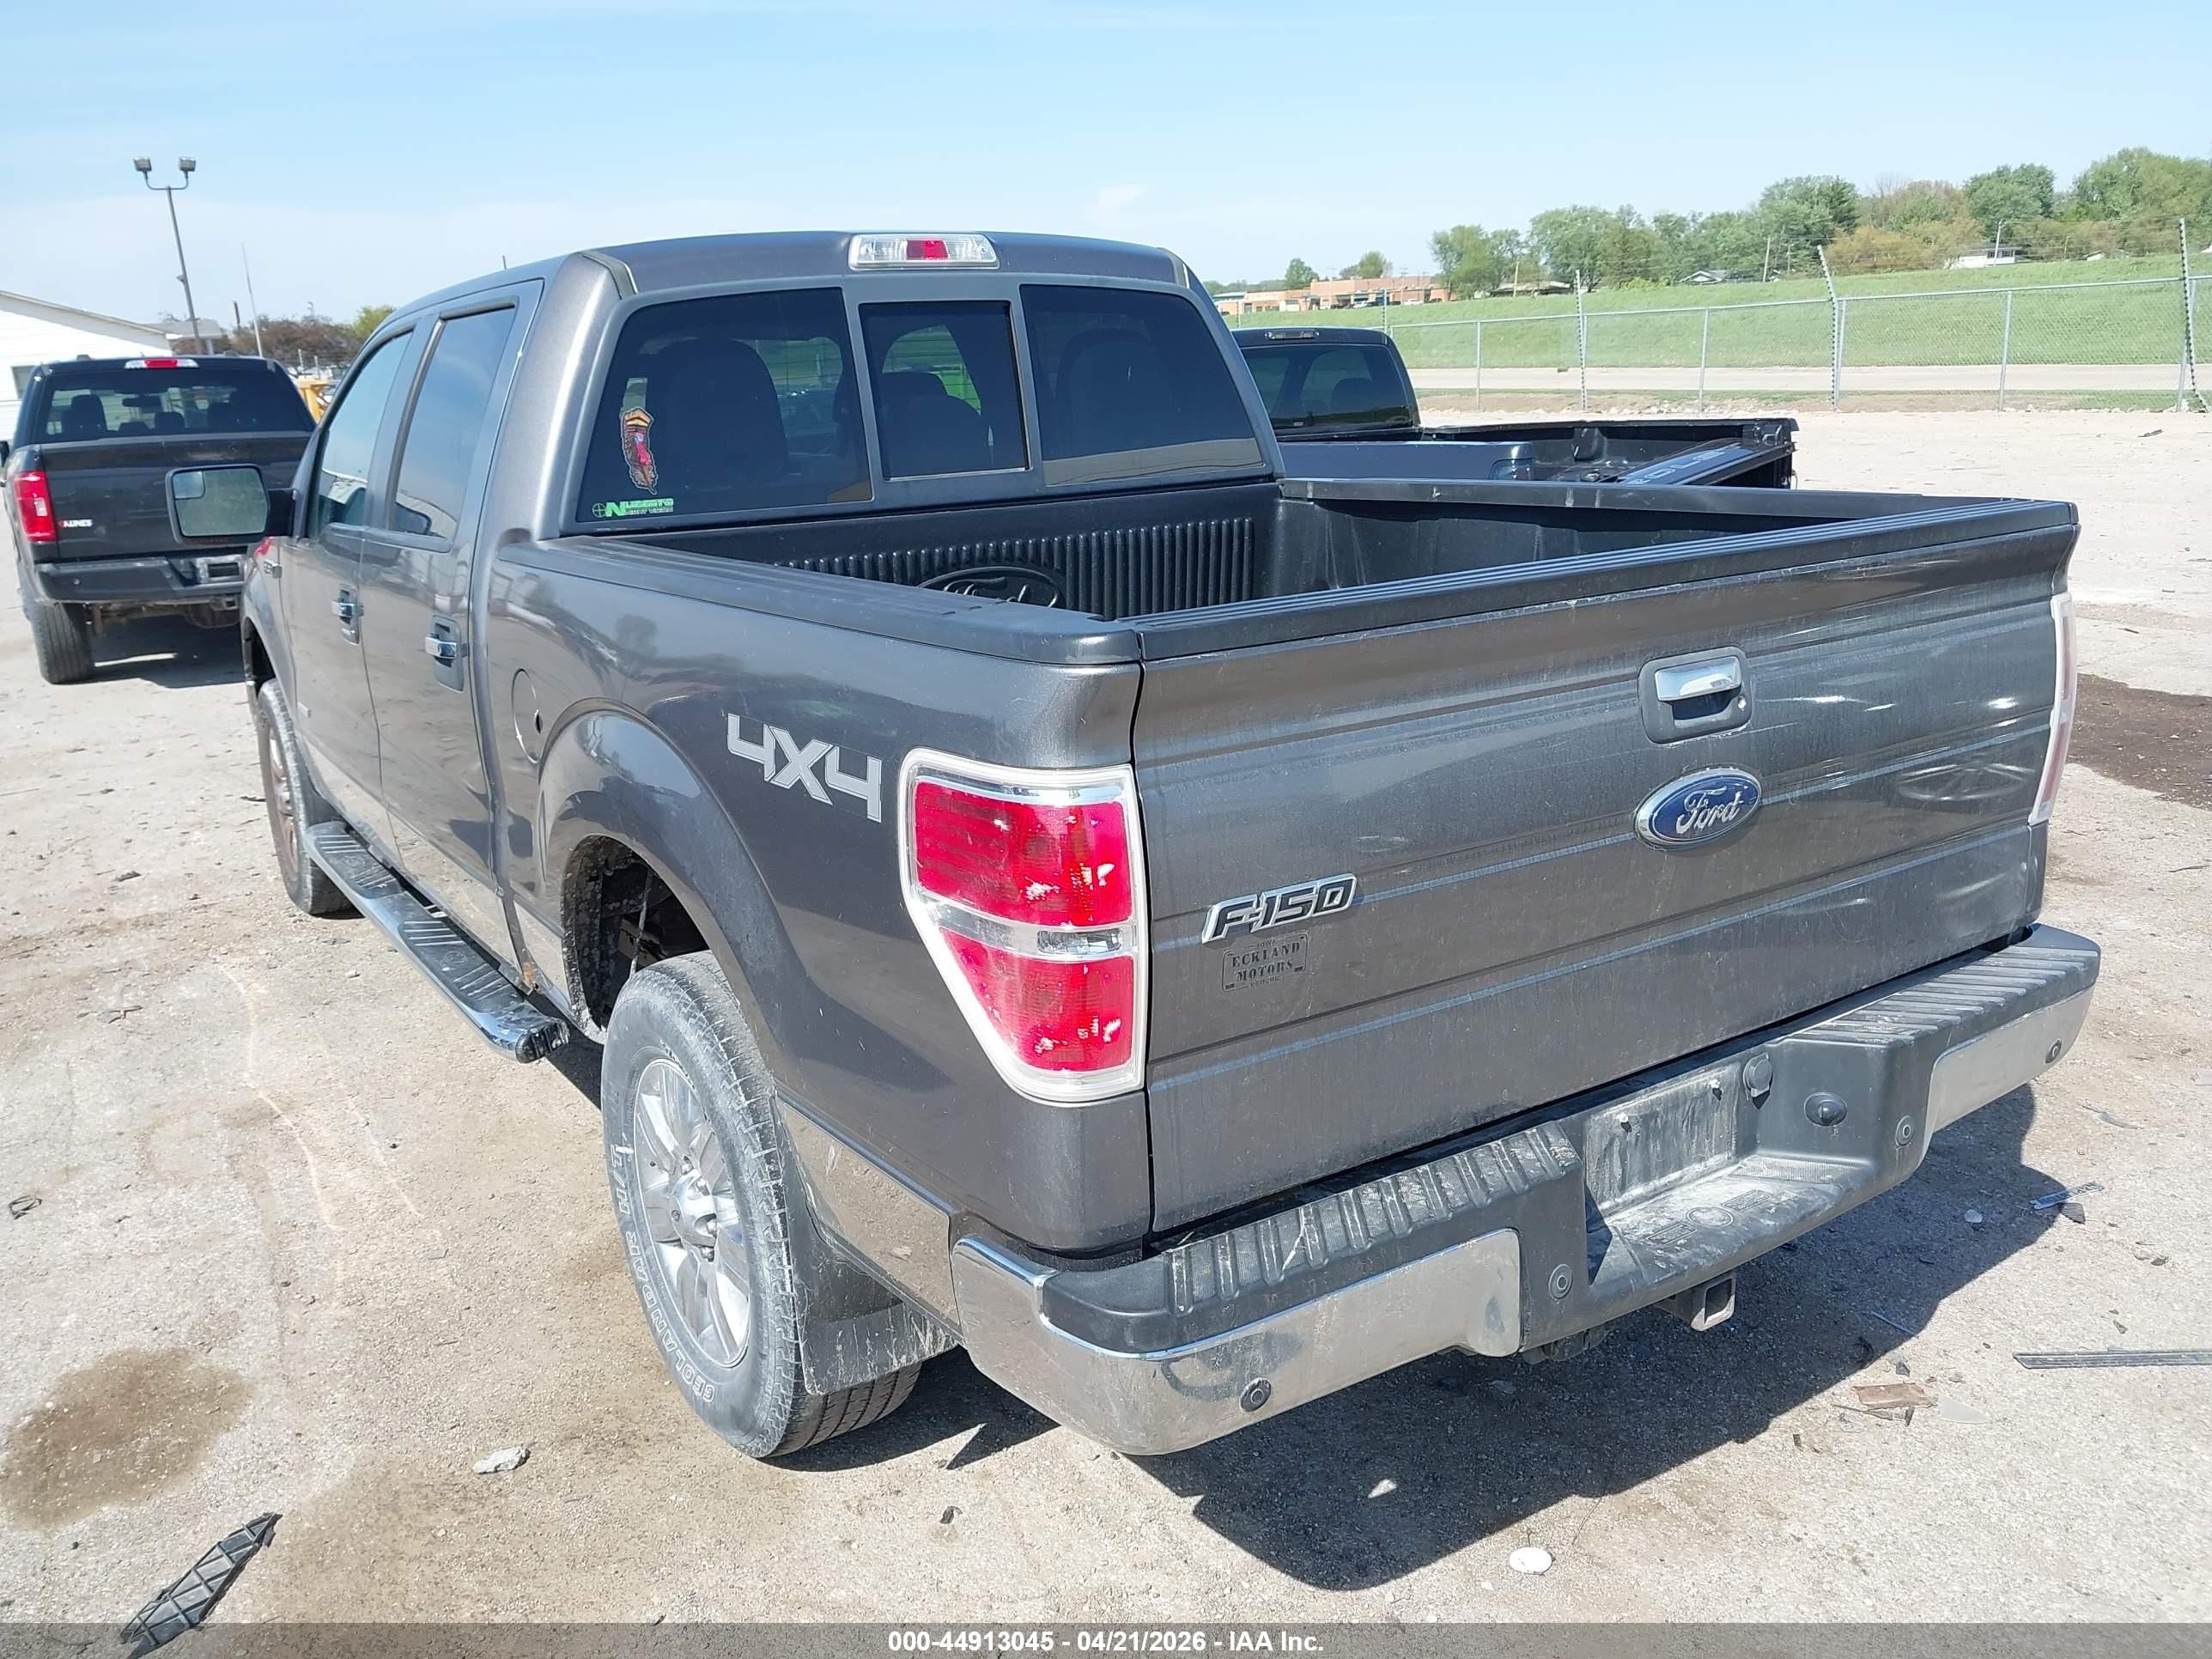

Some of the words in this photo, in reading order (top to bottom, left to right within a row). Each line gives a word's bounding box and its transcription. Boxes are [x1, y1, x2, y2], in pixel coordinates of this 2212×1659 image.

[1675, 785, 1745, 835] Ford
[1201, 872, 1358, 945] F-150
[1231, 942, 1301, 968] ECKLAND
[1256, 938, 1278, 948] IOWA
[1236, 959, 1294, 983] MOTORS
[610, 1142, 634, 1216] H/T
[625, 1230, 716, 1403] GEOLANDAR
